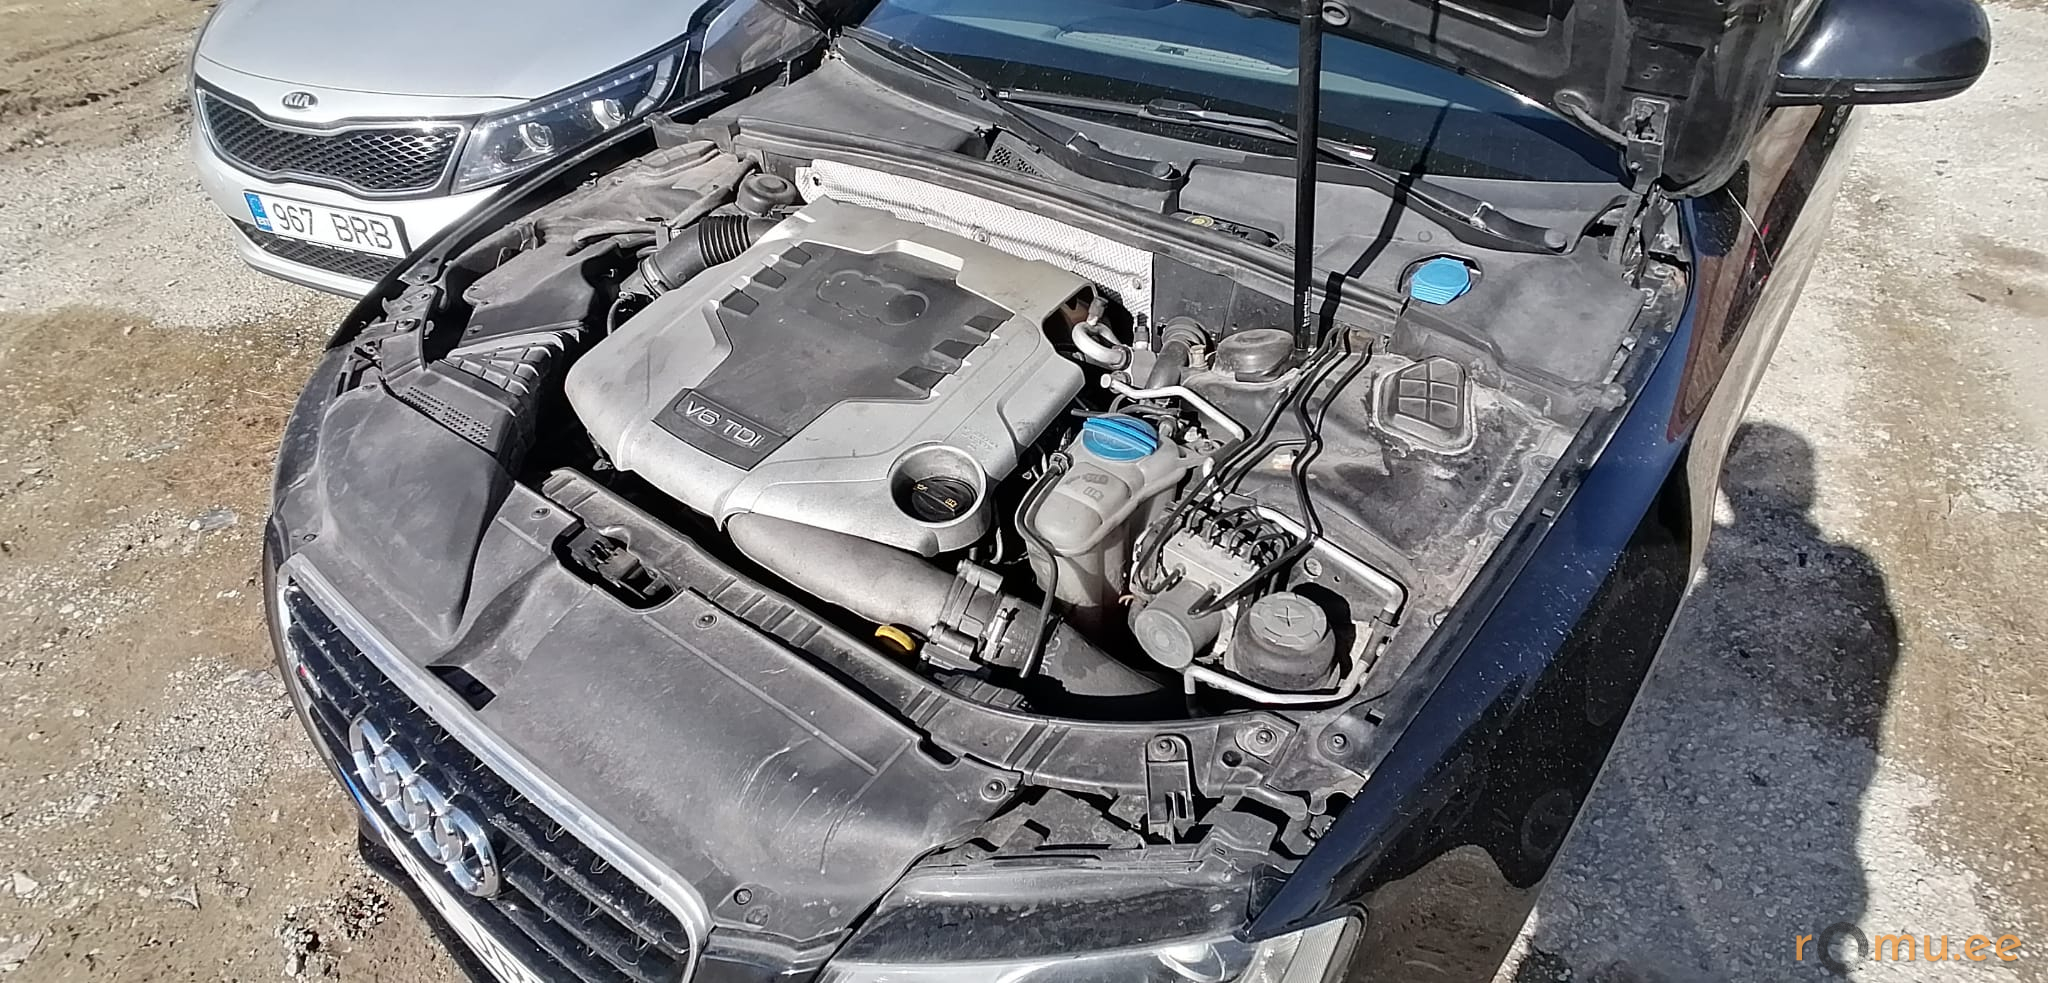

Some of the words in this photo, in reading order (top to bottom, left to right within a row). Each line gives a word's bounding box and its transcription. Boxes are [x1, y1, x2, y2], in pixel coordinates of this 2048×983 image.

[284, 93, 310, 107] KIA
[272, 203, 313, 235] 967
[330, 213, 393, 249] BRB
[686, 400, 721, 425] V6
[723, 419, 763, 447] TDI
